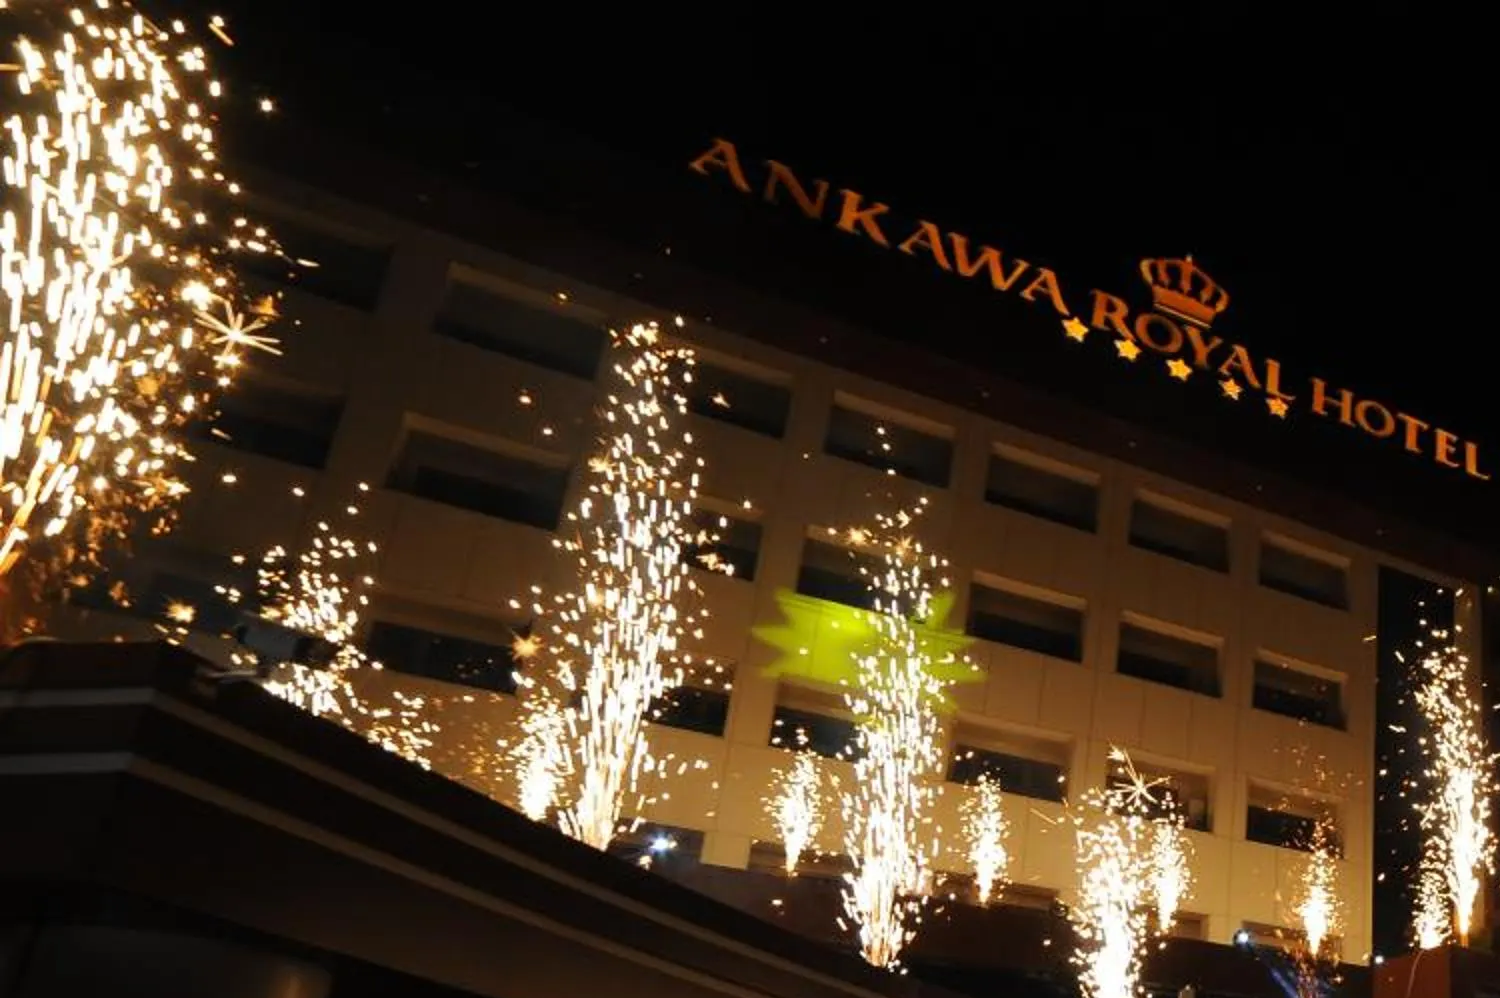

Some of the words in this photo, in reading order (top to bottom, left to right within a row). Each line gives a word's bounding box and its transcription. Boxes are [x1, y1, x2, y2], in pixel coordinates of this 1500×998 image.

[688, 138, 1071, 317] ANKAWA
[1088, 287, 1298, 402] ROYAL
[1310, 376, 1493, 481] HOTEL
